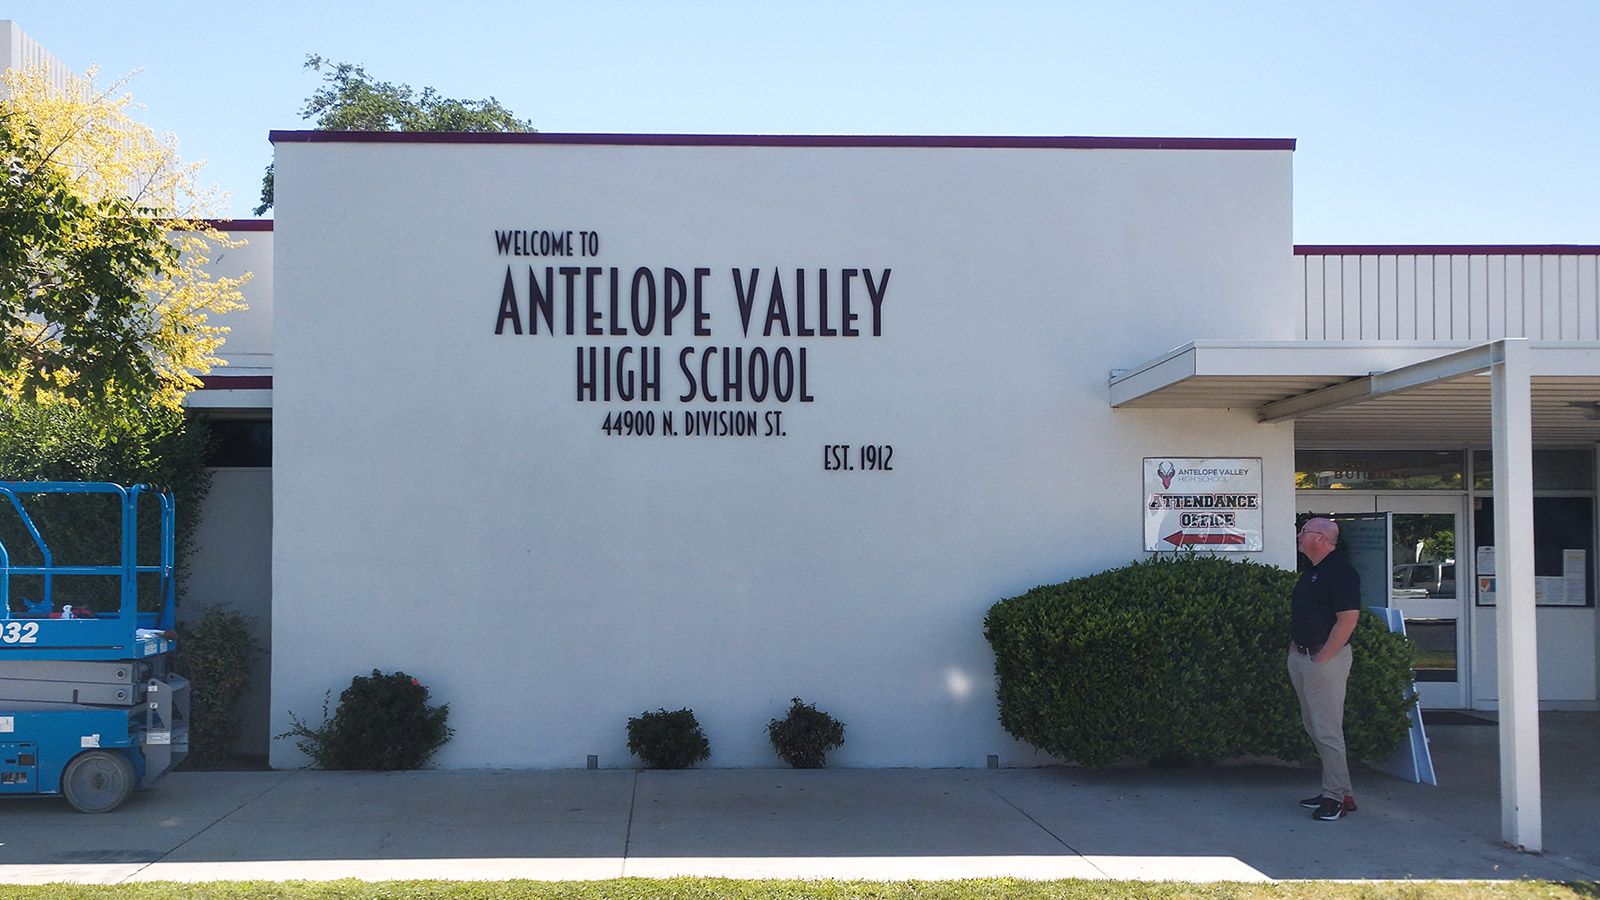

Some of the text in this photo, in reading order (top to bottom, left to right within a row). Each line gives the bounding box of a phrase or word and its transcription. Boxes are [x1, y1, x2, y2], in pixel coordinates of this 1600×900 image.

[495, 230, 598, 256] WELCOME TO
[495, 264, 891, 338] ANTELOPE VALLEY
[577, 346, 814, 403] HIGH SCHOOL
[602, 411, 786, 436] 44900 N. DIVISION ST.
[824, 445, 893, 471] EST. 1912
[1334, 470, 1410, 479] BUILDING
[1150, 494, 1257, 509] ATTENDANCE
[1181, 512, 1235, 528] OFFICE
[0, 621, 39, 643] 32
